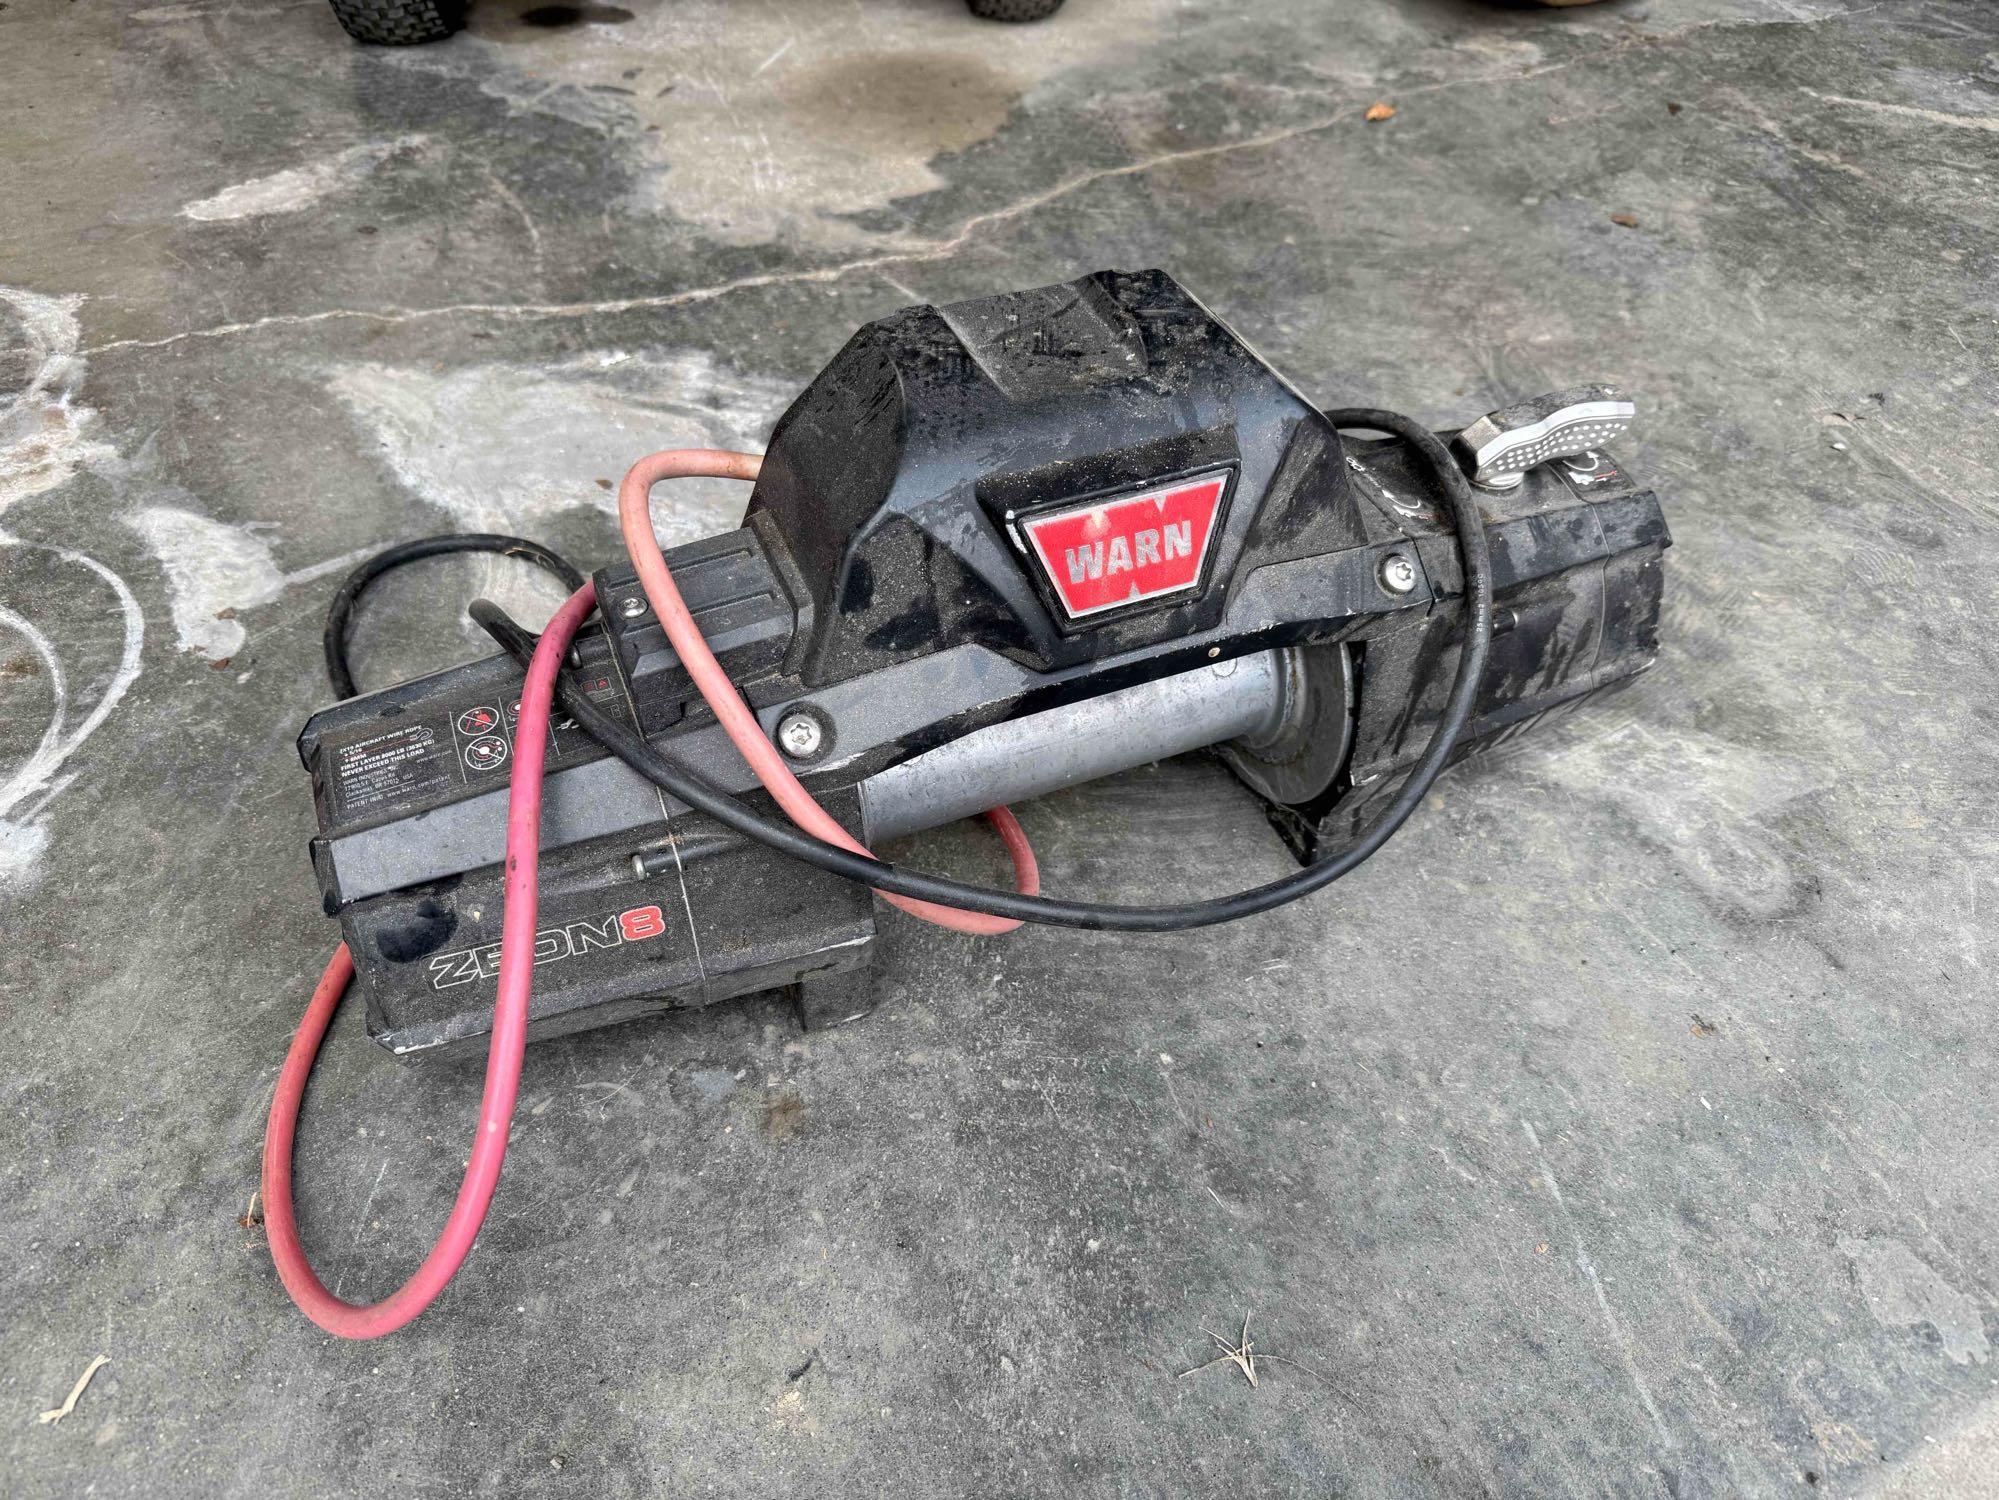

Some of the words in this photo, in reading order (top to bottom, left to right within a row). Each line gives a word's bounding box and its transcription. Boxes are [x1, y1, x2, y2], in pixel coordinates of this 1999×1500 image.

[1065, 520, 1193, 584] WARN
[355, 736, 386, 749] AIRCRAFT
[386, 730, 403, 741] WIRE
[404, 725, 423, 734] ROPE
[341, 762, 359, 771] FIRST
[361, 756, 380, 766] LAYER
[382, 750, 396, 759] 8000
[397, 747, 405, 755] LB
[423, 739, 435, 747] KG)
[342, 767, 364, 777] NEVER
[365, 759, 389, 770] EXCEED
[390, 754, 406, 763] THIS
[407, 748, 425, 758] LOAD
[402, 773, 414, 781] USA
[346, 799, 369, 809] PATENT
